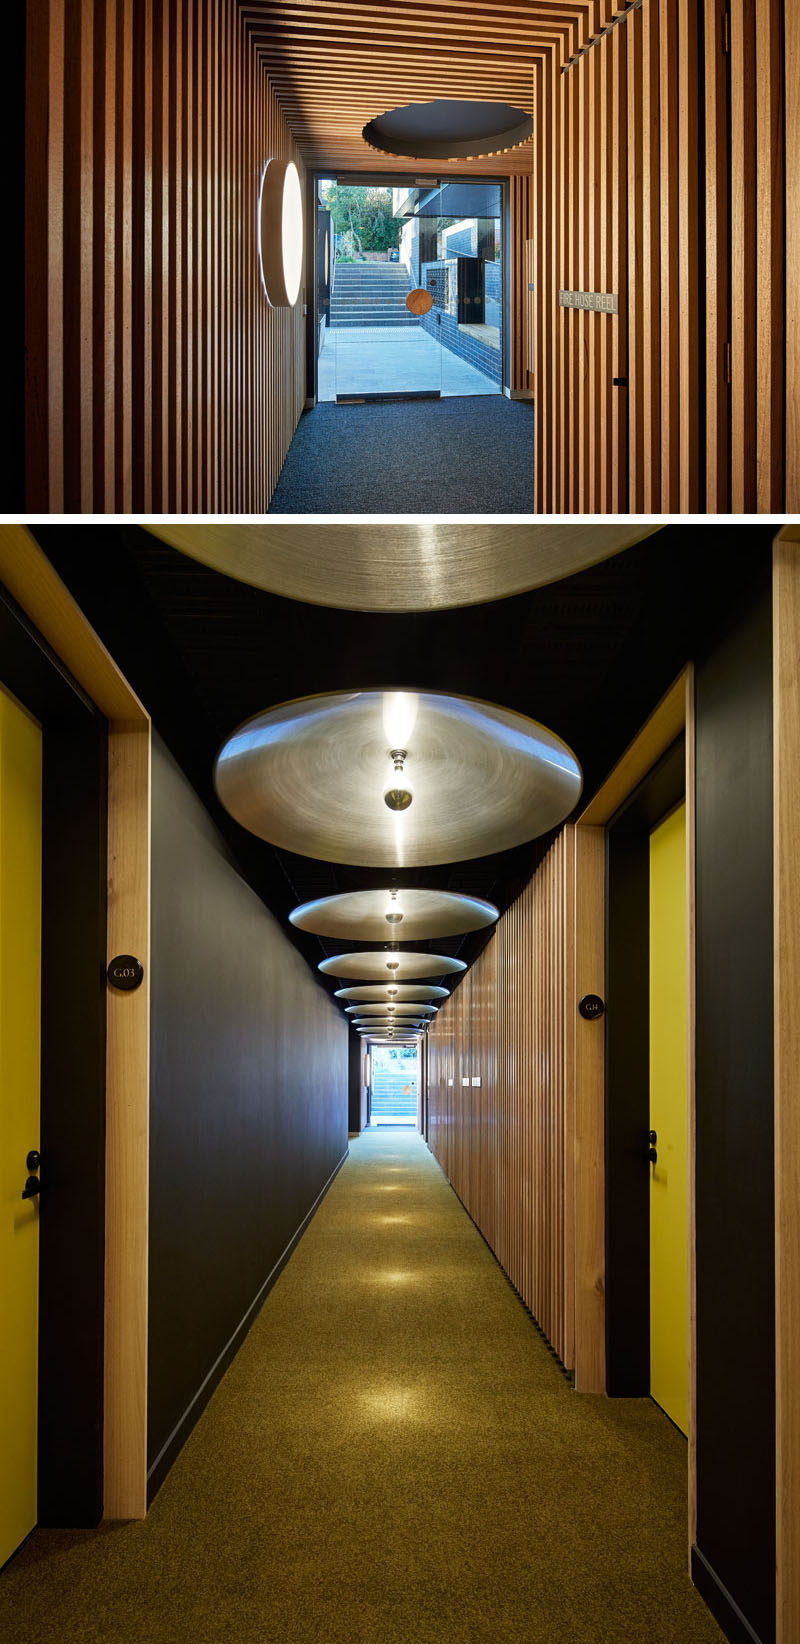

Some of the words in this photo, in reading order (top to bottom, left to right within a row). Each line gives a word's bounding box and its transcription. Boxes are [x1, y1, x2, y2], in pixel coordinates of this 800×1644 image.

[560, 293, 574, 305] FIRE
[575, 294, 594, 308] HOSE
[596, 295, 617, 311] REEL
[113, 968, 135, 977] G.03
